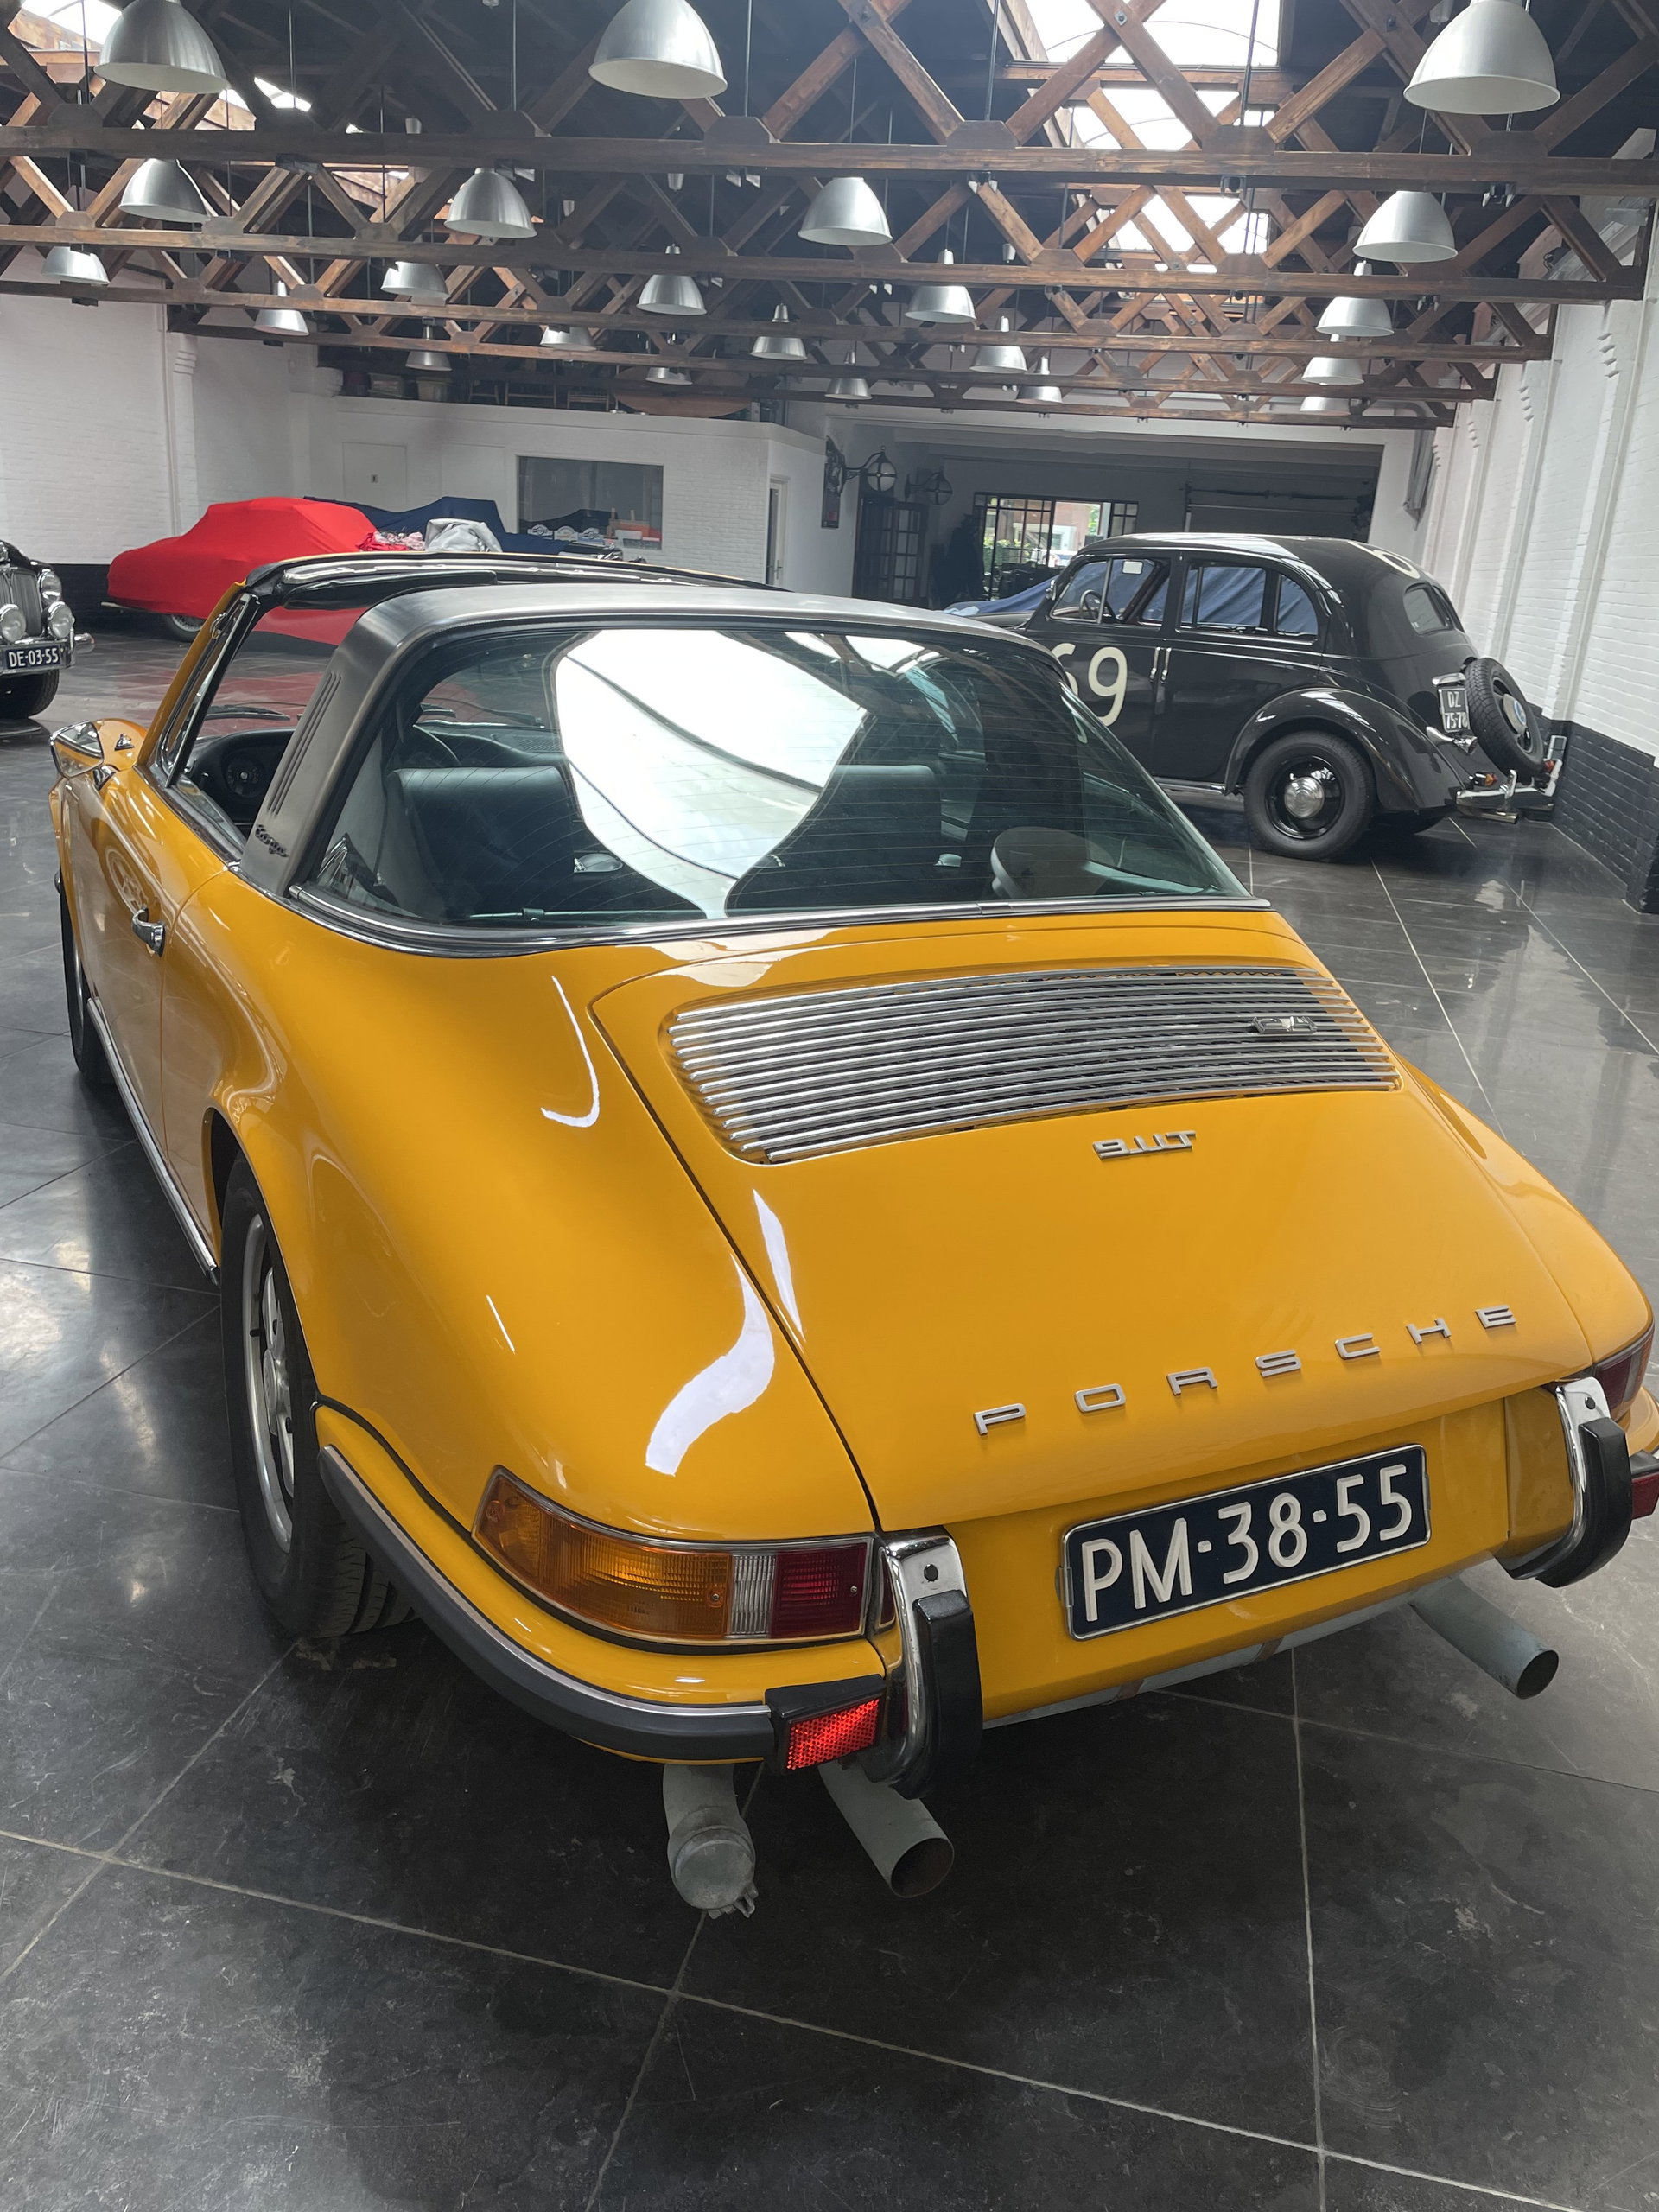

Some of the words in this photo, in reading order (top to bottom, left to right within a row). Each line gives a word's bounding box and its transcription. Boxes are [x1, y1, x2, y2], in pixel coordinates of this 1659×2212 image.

[8, 647, 59, 668] DE-03-55
[1447, 691, 1461, 708] DZ
[974, 1304, 1516, 1435] PORSCHE
[1081, 1464, 1413, 1622] PM-38-55
